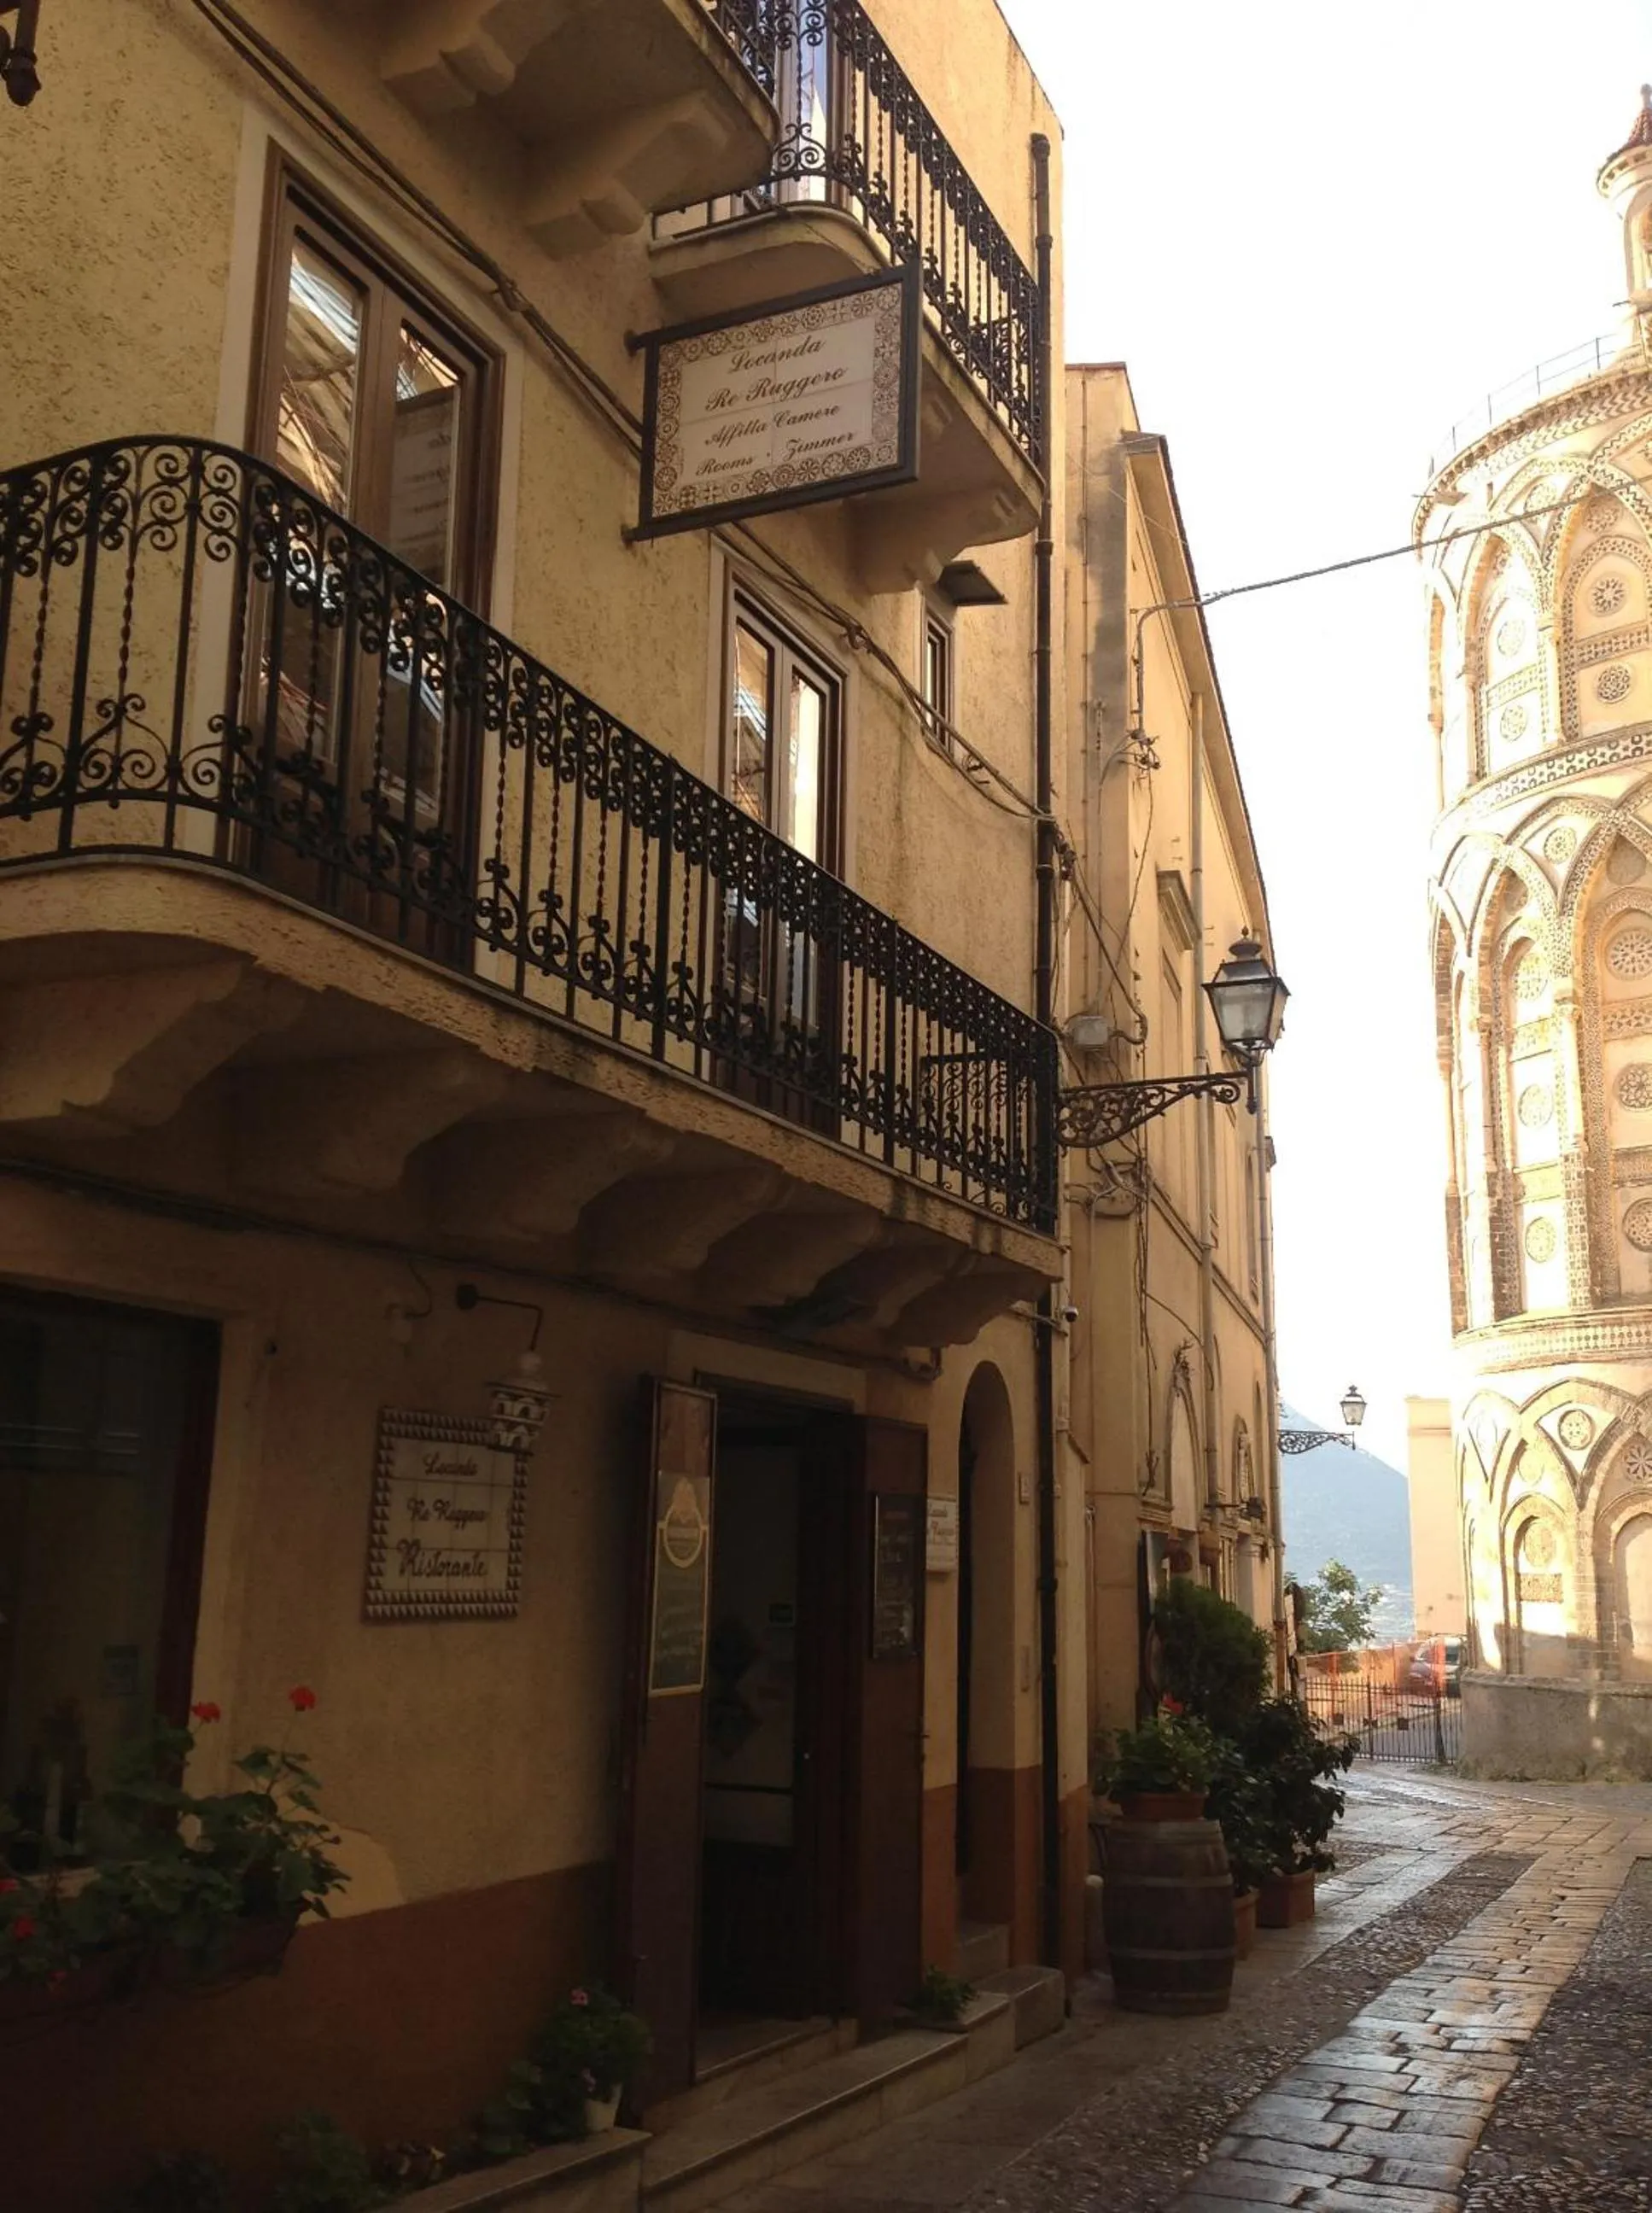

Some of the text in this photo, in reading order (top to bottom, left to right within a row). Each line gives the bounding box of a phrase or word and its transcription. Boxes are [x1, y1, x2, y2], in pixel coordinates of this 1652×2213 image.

[727, 336, 826, 375] Locanda
[704, 366, 849, 412] Re Ruggero
[772, 405, 840, 429] Camere
[695, 430, 855, 476] Rooms Zimmer
[396, 1538, 487, 1578] Ristorante
